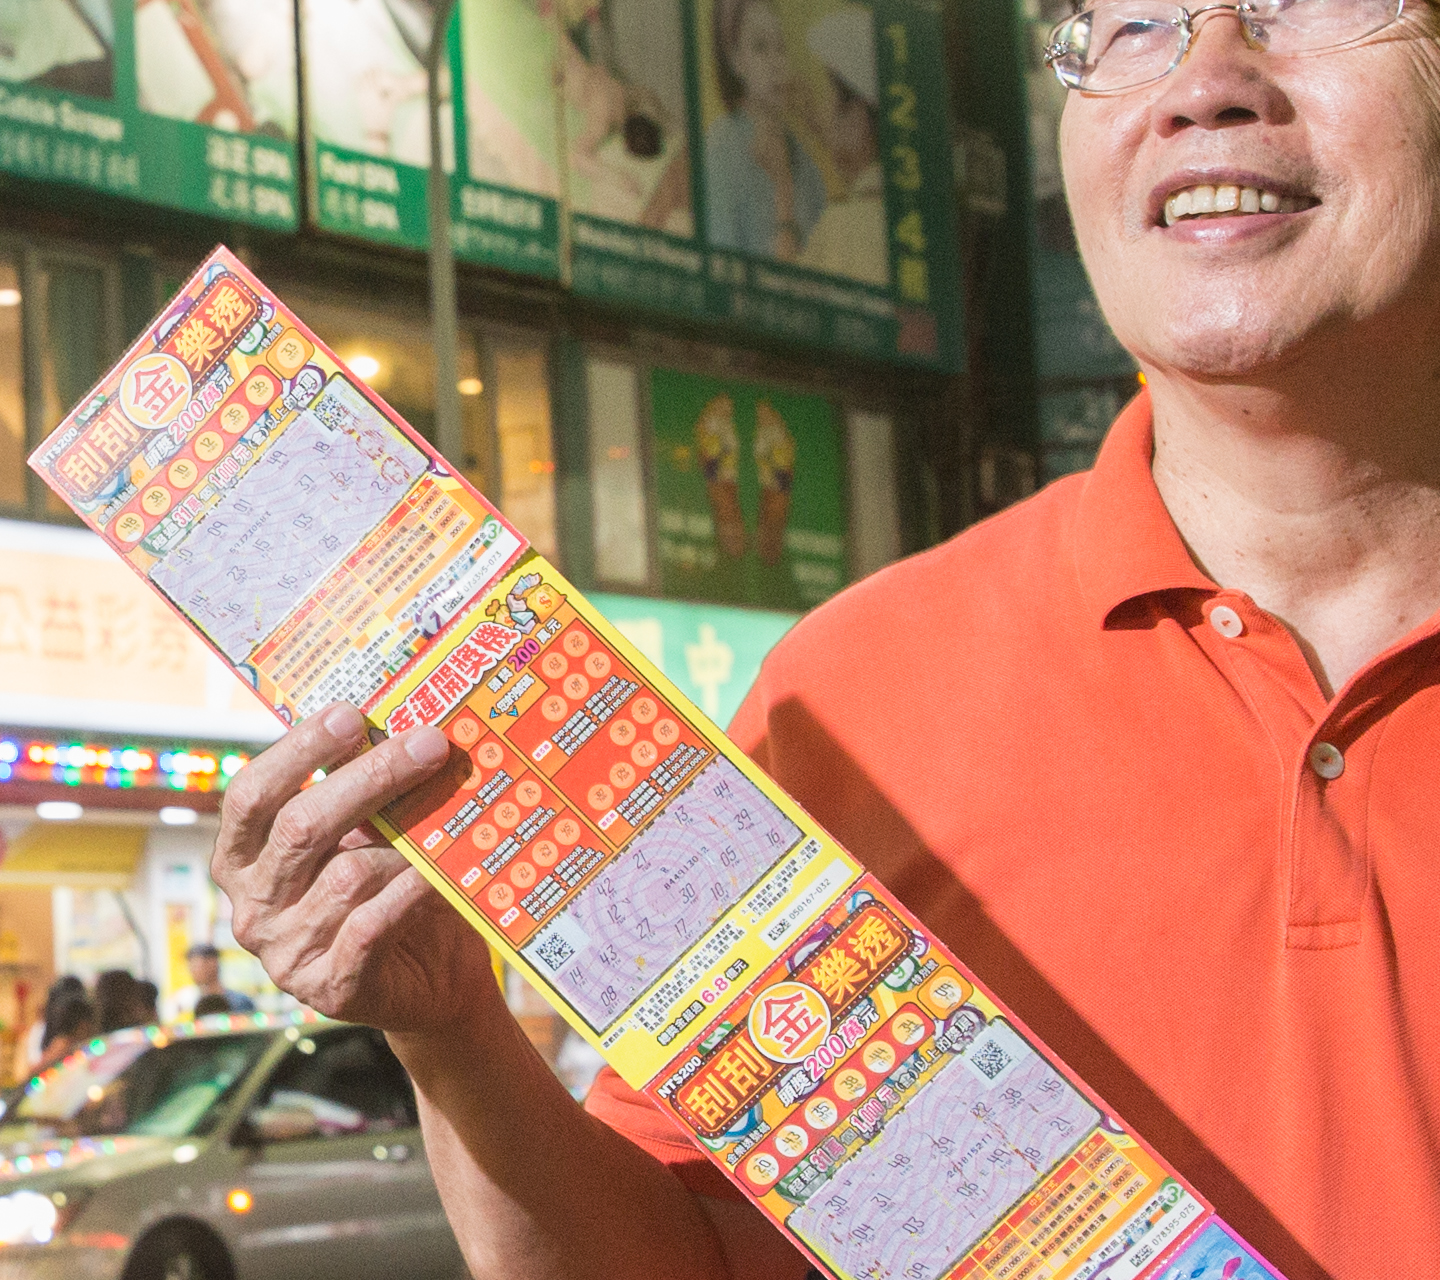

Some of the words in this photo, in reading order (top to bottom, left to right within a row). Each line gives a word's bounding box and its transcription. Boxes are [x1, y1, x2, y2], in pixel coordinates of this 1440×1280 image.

[56, 281, 257, 494] 刮刮金樂透
[38, 426, 79, 468] NT$200
[713, 781, 731, 798] 44
[673, 807, 688, 823] 13
[732, 809, 752, 829] 39
[766, 830, 780, 844] 16
[631, 851, 647, 868] 21
[719, 847, 737, 865] 05
[597, 878, 615, 896] 42
[677, 884, 696, 903] 30
[710, 883, 726, 899] 10
[787, 876, 831, 921] 050167-032
[606, 905, 622, 921] 12
[634, 919, 653, 938] 27
[599, 945, 618, 965] 43
[569, 968, 584, 982] 14
[598, 986, 618, 1006] 08
[677, 908, 906, 1129] 刮刮金樂透
[773, 1000, 881, 1109] 頭獎200萬元
[657, 1054, 702, 1099] NT$200
[1151, 1201, 1197, 1247] 078395-075
